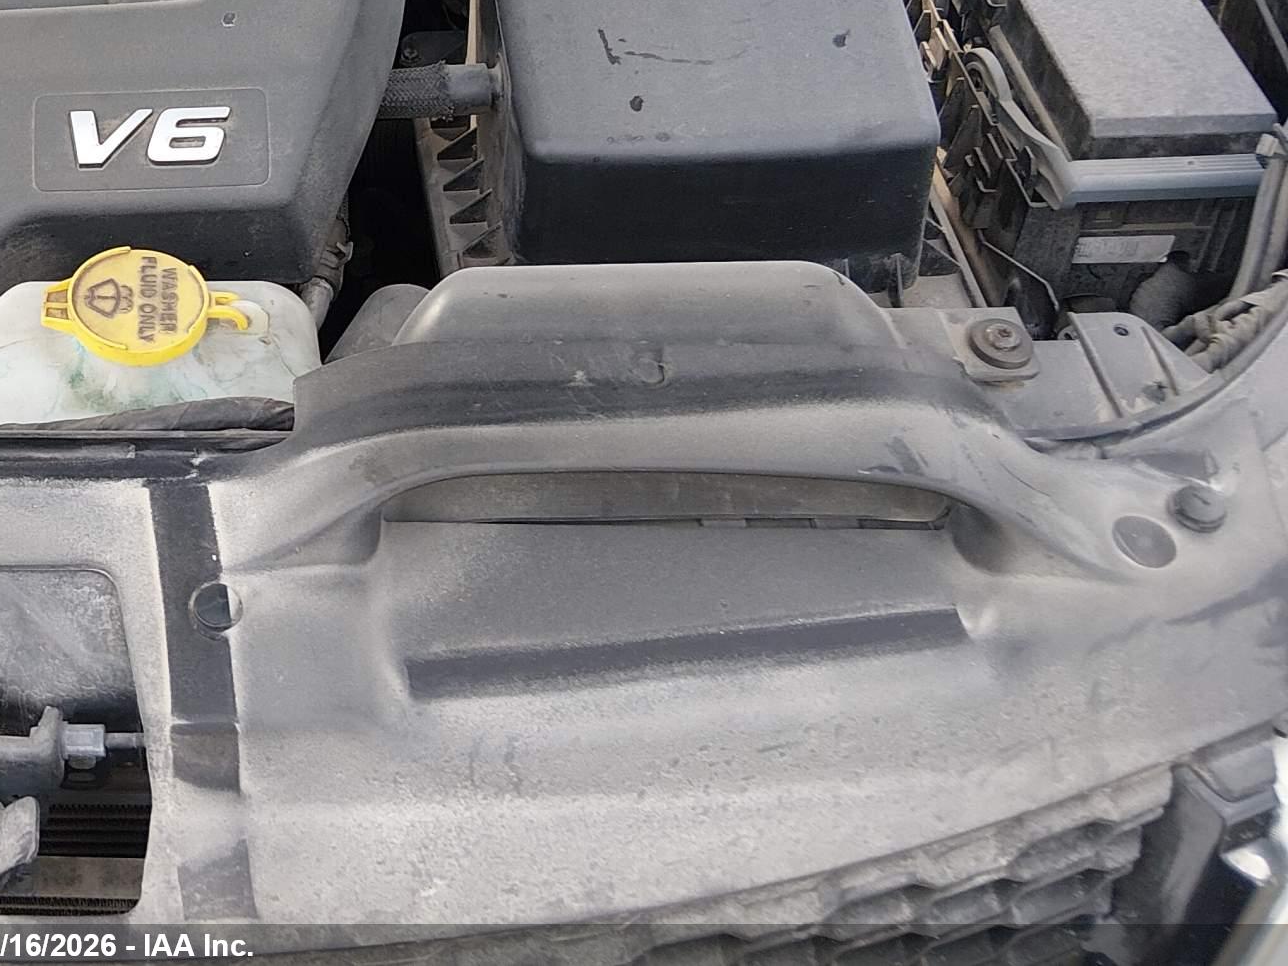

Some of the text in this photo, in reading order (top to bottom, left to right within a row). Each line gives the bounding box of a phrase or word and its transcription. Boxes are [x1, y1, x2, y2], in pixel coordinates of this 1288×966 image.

[68, 106, 232, 169] V6
[136, 256, 158, 345] FLUID ONLY
[159, 267, 180, 334] WASHER
